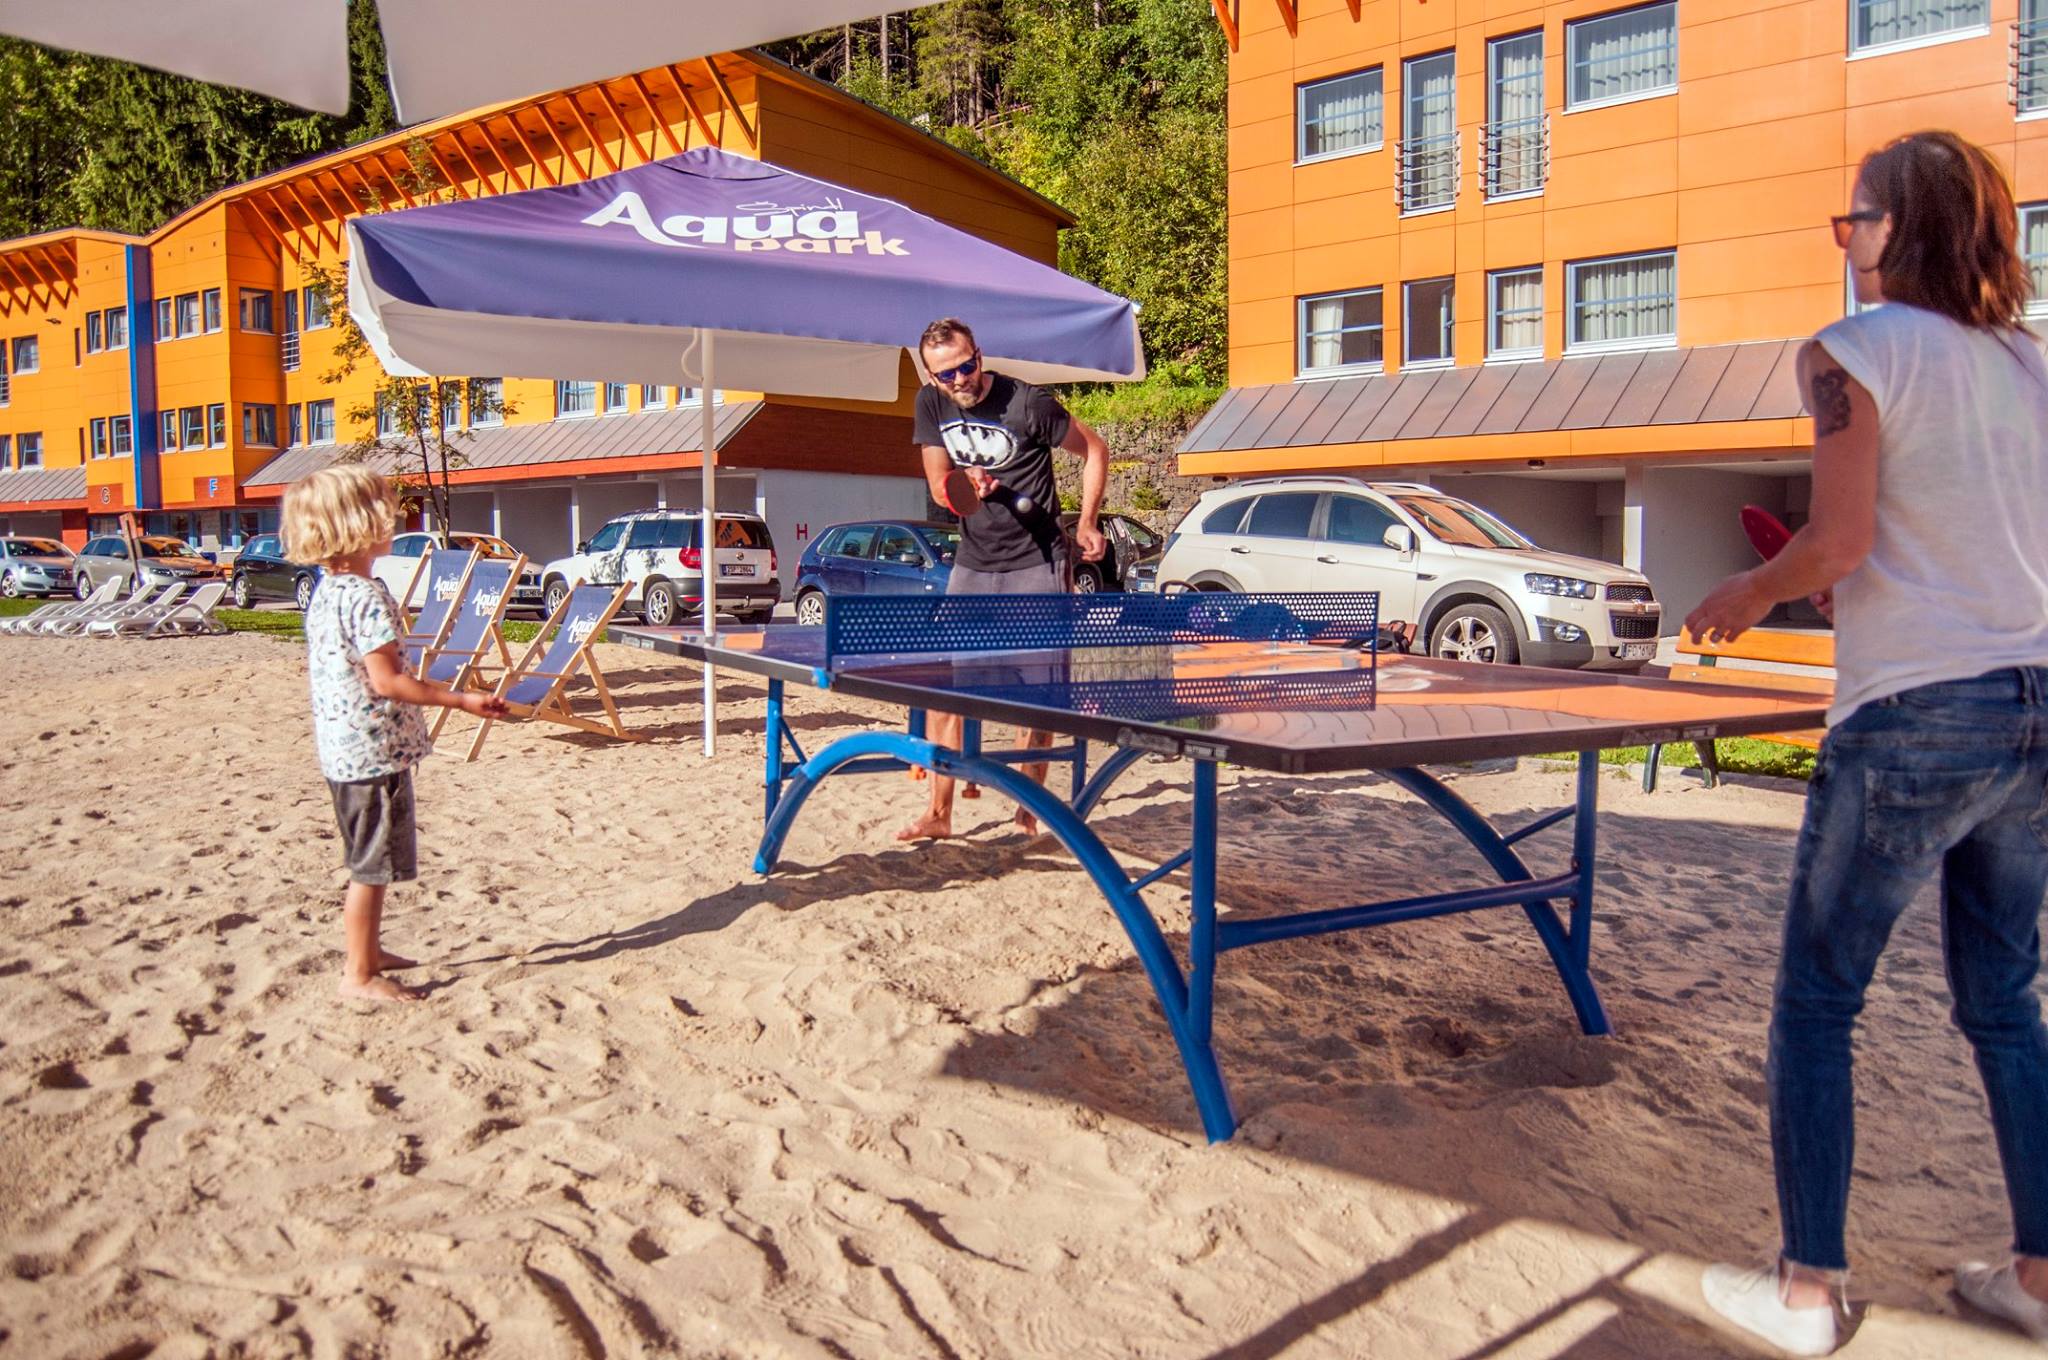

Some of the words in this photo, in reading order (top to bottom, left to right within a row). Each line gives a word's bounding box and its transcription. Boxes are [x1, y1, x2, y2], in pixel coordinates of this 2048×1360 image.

[581, 191, 859, 249] Aqua
[735, 231, 911, 256] park
[209, 478, 218, 498] F
[796, 523, 808, 541] H
